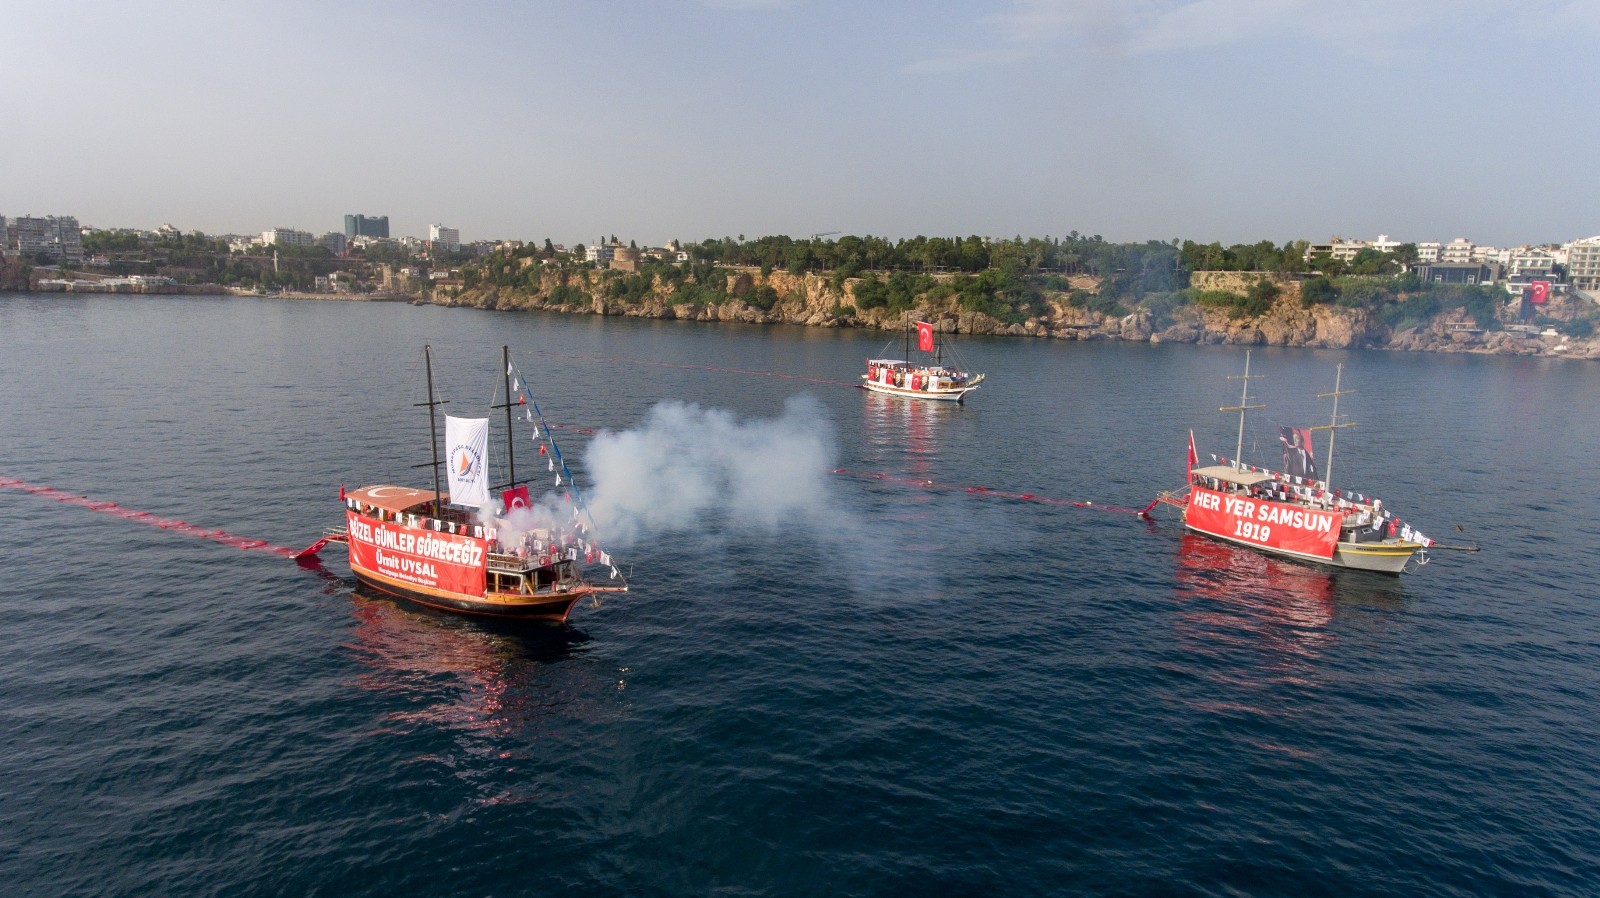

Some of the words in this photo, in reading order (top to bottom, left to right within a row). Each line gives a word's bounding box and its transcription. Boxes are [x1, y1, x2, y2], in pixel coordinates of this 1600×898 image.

[1193, 490, 1221, 512] HER
[1224, 497, 1255, 519] YER
[1257, 504, 1333, 533] SAMSUN
[375, 524, 415, 554] GÜNLER
[416, 532, 483, 567] GÖRECEĞİZ
[1235, 521, 1271, 542] 1919
[376, 548, 399, 568] Ümit
[401, 557, 438, 579] UYSAL
